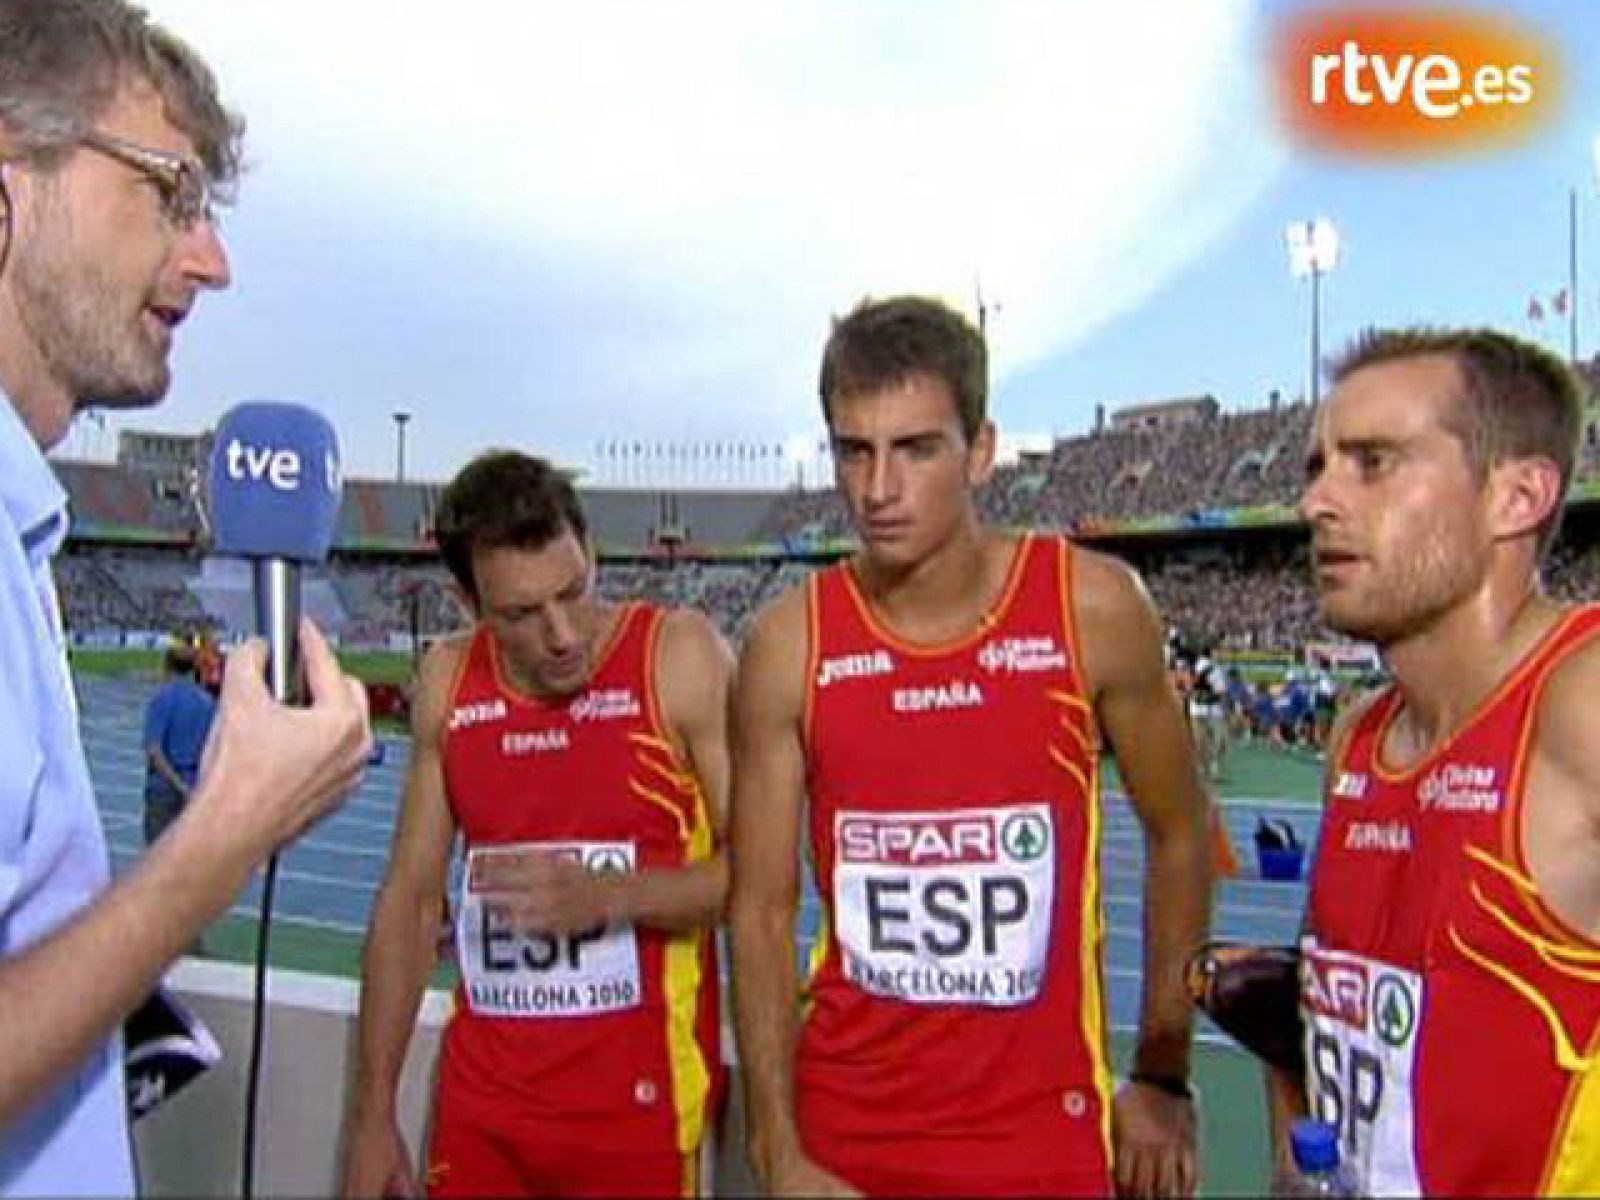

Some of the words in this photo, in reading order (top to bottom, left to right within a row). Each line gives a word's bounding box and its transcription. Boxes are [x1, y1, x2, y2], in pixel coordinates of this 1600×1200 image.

[226, 439, 300, 490] tve
[842, 821, 993, 863] SPAR
[865, 874, 1030, 957] ESP
[1313, 1033, 1384, 1155] SP
